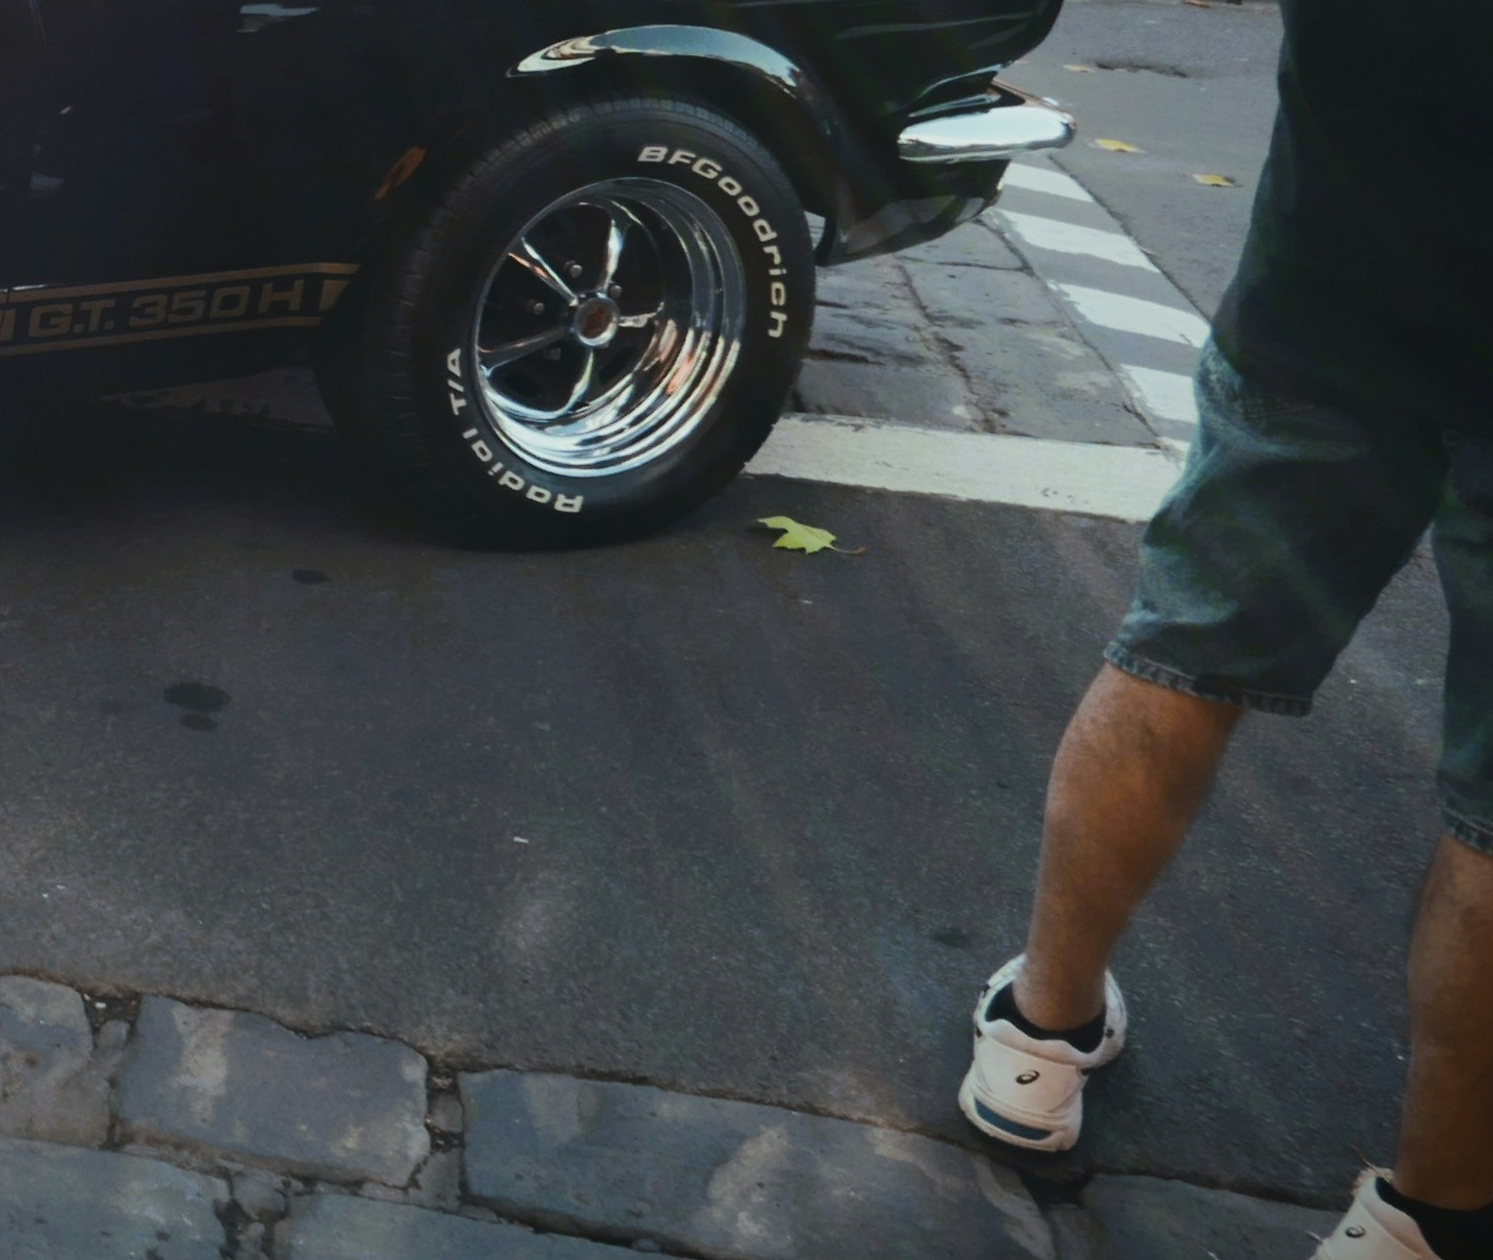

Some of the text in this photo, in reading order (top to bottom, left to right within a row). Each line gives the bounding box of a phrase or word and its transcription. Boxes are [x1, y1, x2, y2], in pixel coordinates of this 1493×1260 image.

[636, 145, 788, 339] BFGoodrich
[446, 347, 467, 416] T/A
[462, 427, 584, 514] Radial
